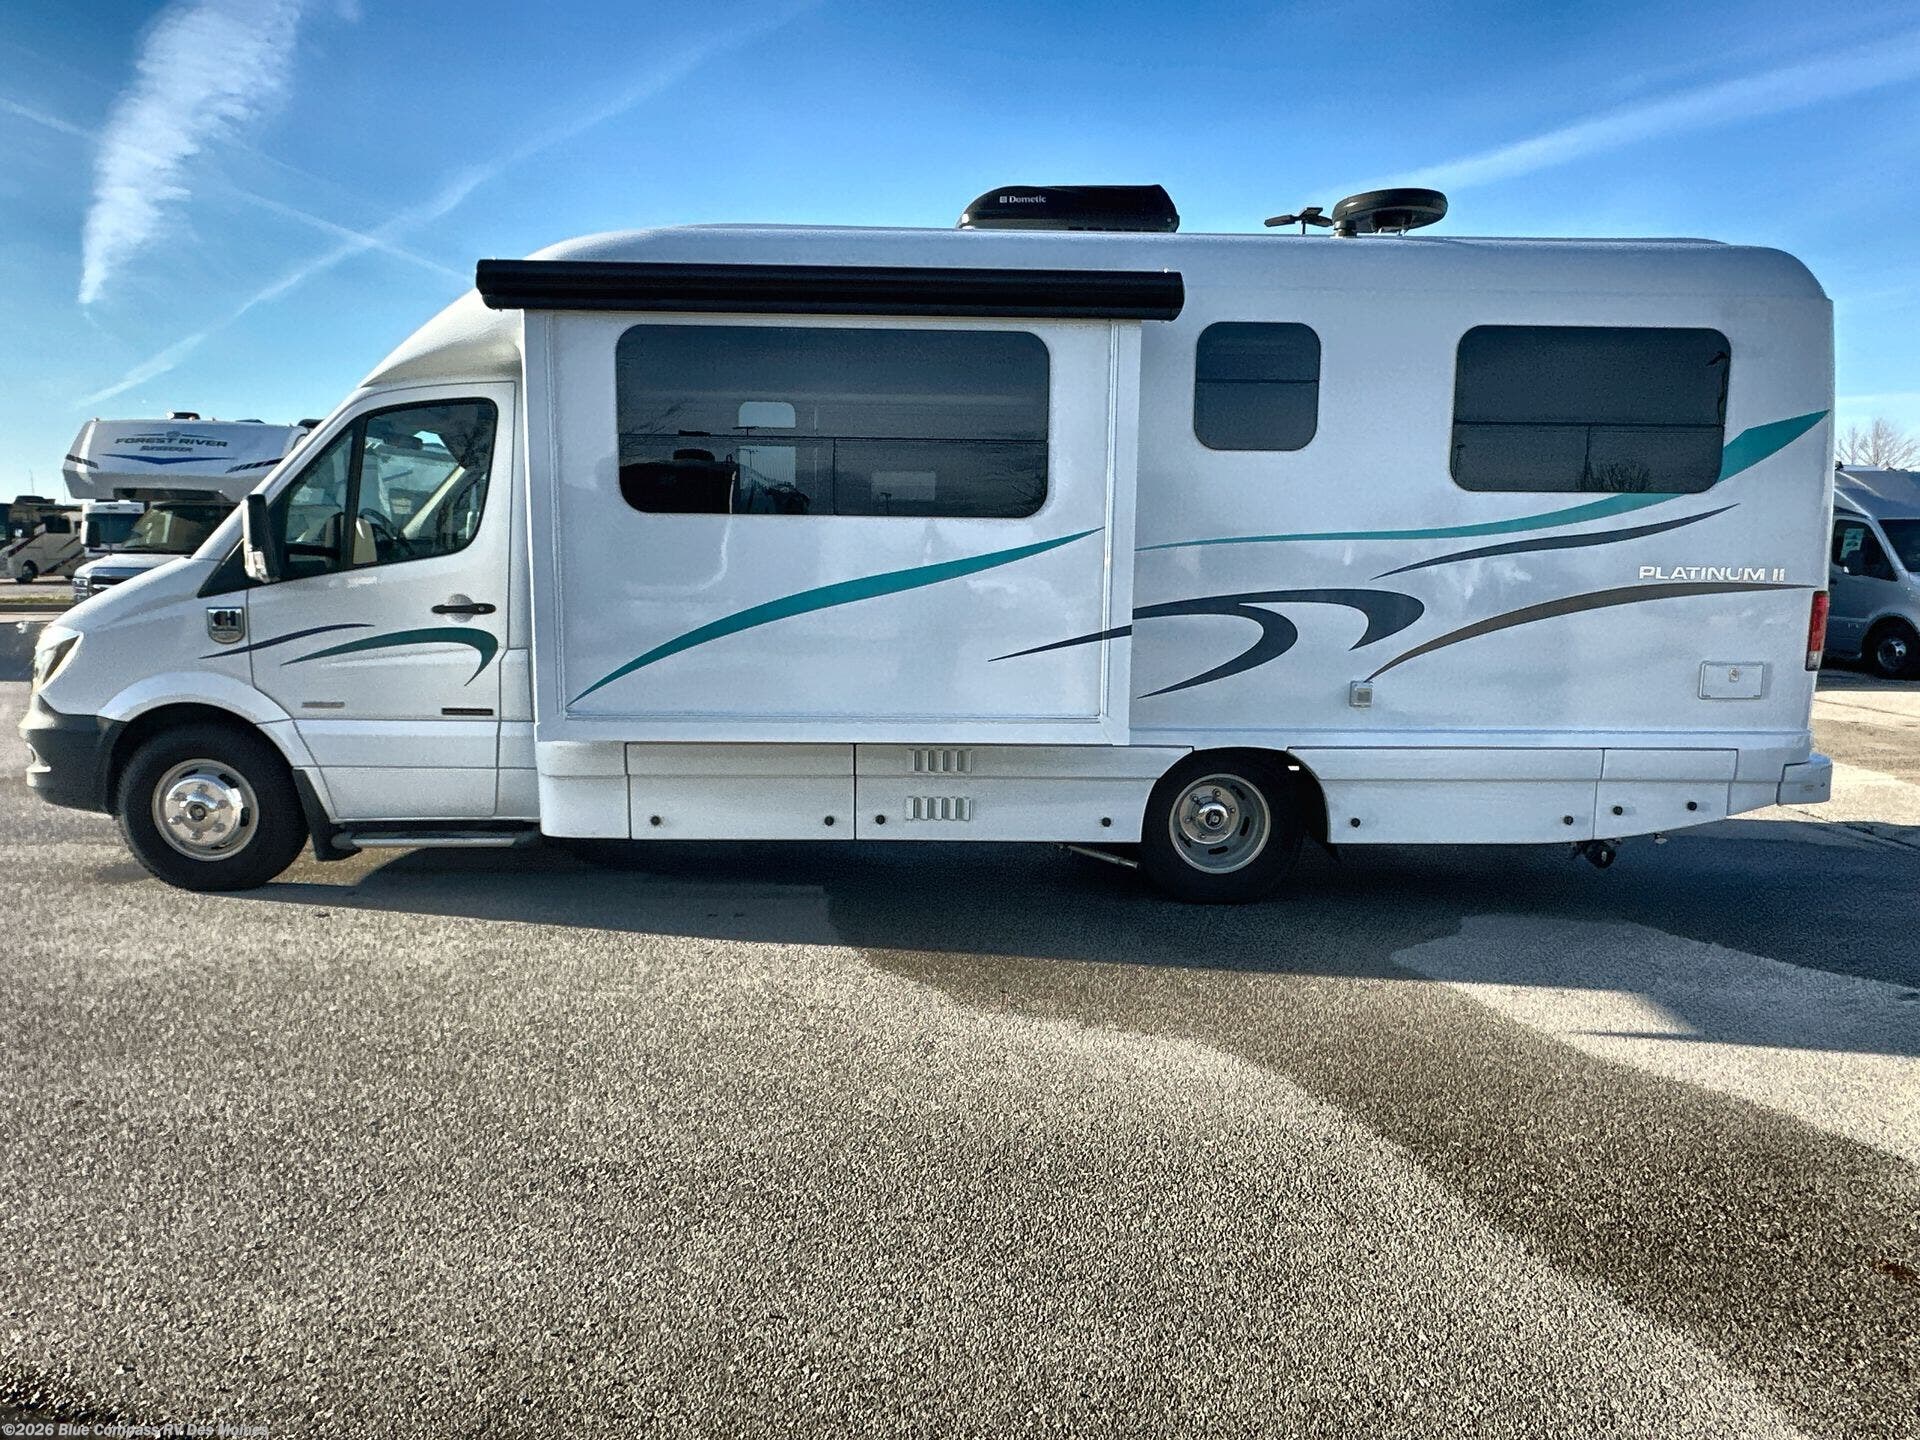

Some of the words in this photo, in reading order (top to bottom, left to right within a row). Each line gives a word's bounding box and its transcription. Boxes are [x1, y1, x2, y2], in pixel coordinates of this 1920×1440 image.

[1009, 194, 1047, 204] Dometic
[115, 437, 177, 445] FOREST
[179, 438, 228, 448] RIVER
[1638, 565, 1766, 582] PLATINUM
[1772, 567, 1786, 582] II
